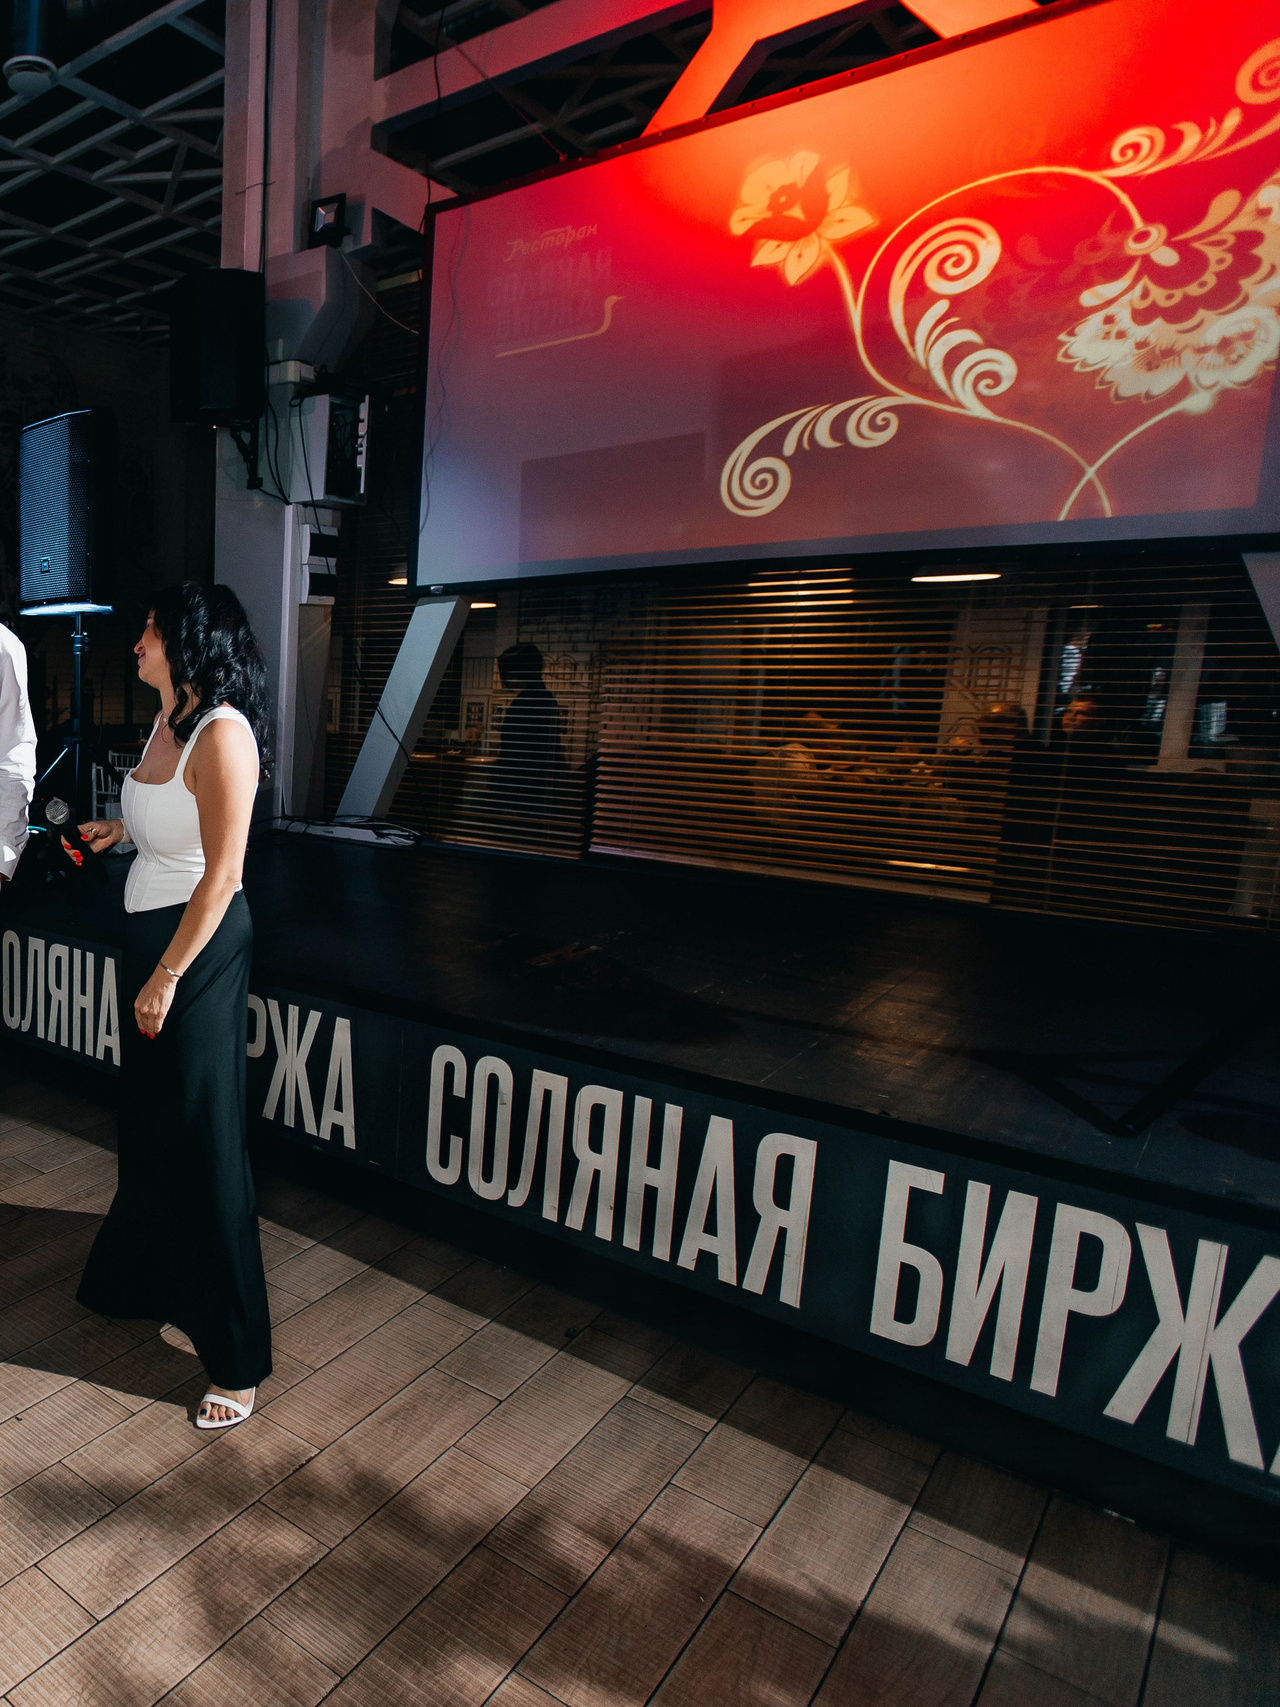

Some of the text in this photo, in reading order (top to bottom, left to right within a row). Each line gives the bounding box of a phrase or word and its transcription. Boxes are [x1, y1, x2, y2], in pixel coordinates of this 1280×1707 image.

[503, 223, 598, 262] Ресторан
[246, 993, 356, 1150] РЖА
[426, 1044, 1280, 1477] СОЛЯНАЯ БИРЖ
